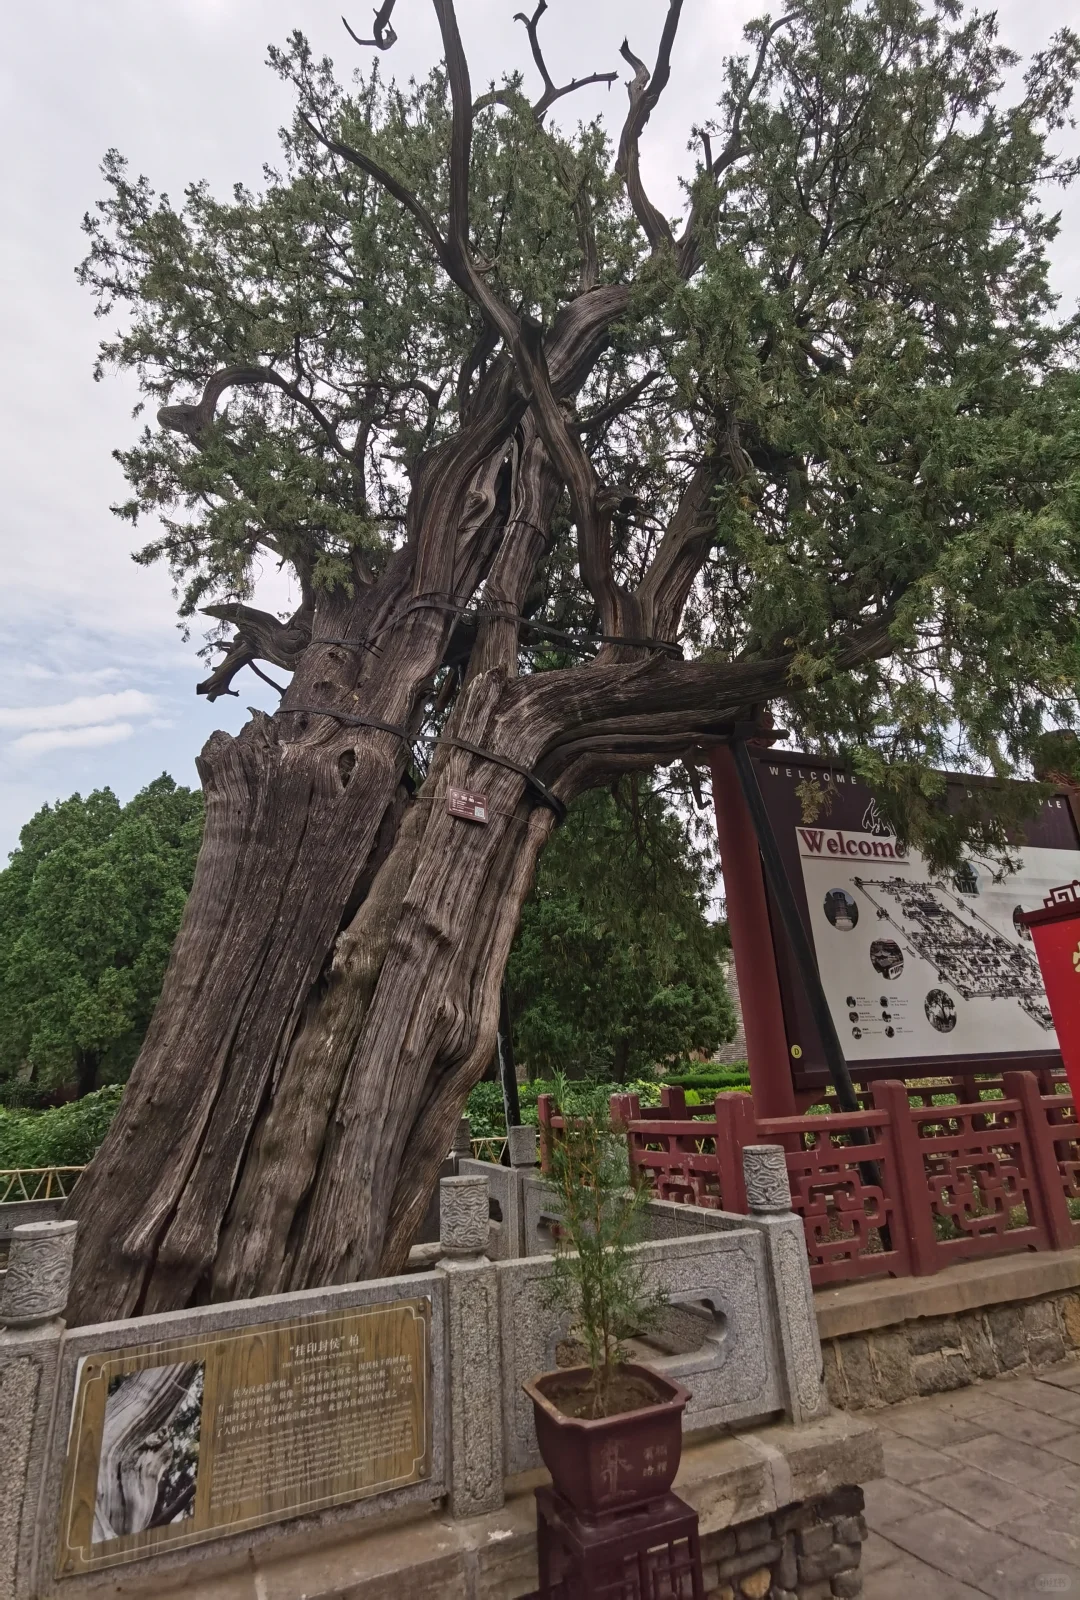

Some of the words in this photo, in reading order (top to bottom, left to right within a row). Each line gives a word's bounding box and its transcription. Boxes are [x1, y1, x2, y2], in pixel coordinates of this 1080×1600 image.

[769, 766, 857, 785] WELCOME
[797, 829, 907, 859] Welcome
[794, 1047, 800, 1056] D
[328, 1349, 351, 1359] CYPRESS
